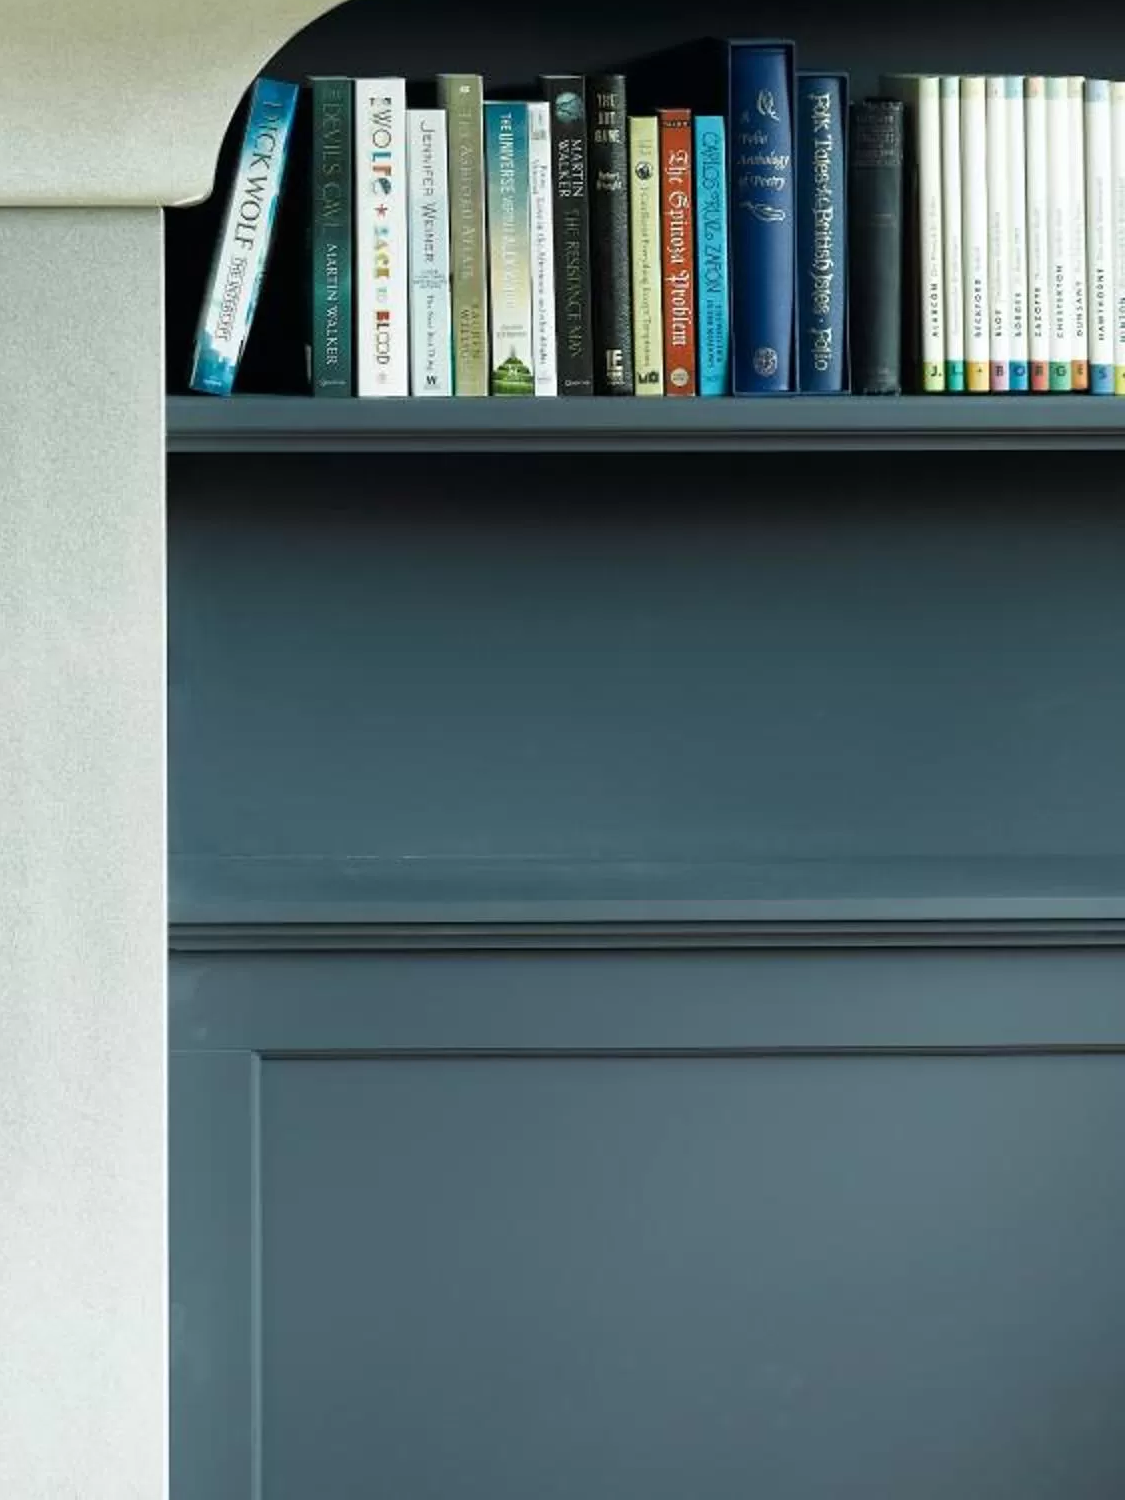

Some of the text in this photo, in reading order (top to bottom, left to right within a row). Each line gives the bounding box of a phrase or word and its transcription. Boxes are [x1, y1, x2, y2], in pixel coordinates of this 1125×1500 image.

[420, 120, 437, 197] JENNIFER
[499, 113, 515, 193] THE UNIVERSE
[557, 140, 571, 198] WALKER
[570, 139, 583, 198] MARTIN
[666, 149, 689, 184] The
[701, 131, 723, 191] CARLOS
[233, 175, 269, 251] WOLF
[422, 202, 439, 263] WEINER
[668, 191, 690, 264] Spinoza
[807, 93, 834, 370] Folk Tales British Isles Folio
[325, 243, 340, 365] MARTIN WALKER
[565, 241, 582, 321] RESISTANCE
[664, 269, 690, 347] Problem
[1056, 265, 1064, 338] CHESTERTON
[375, 310, 392, 365] BLOOD
